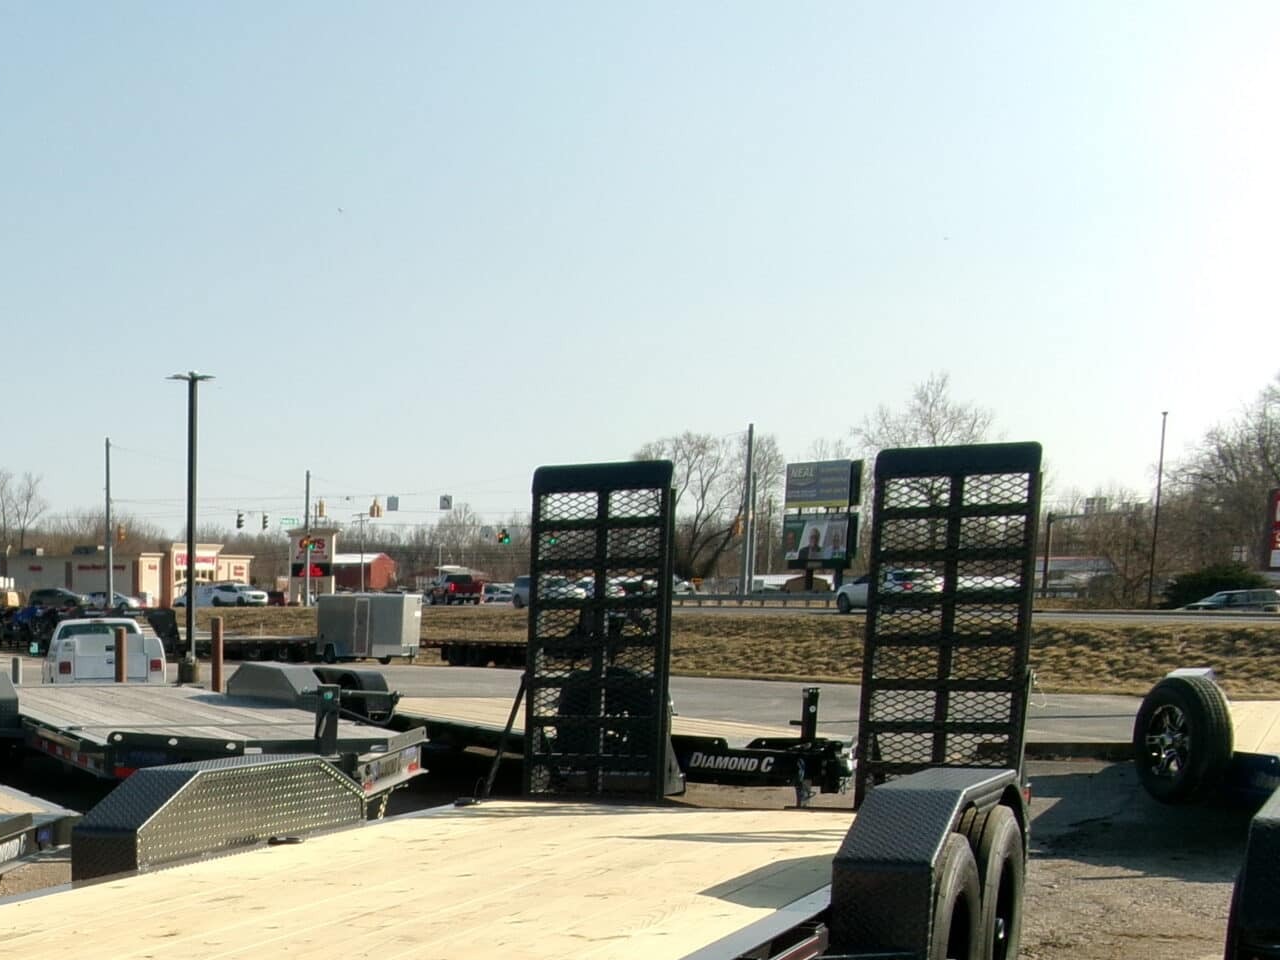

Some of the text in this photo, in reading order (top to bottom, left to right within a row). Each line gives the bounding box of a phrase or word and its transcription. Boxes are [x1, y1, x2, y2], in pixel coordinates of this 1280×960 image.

[299, 537, 326, 550] CS
[689, 752, 775, 772] DIAMOND C
